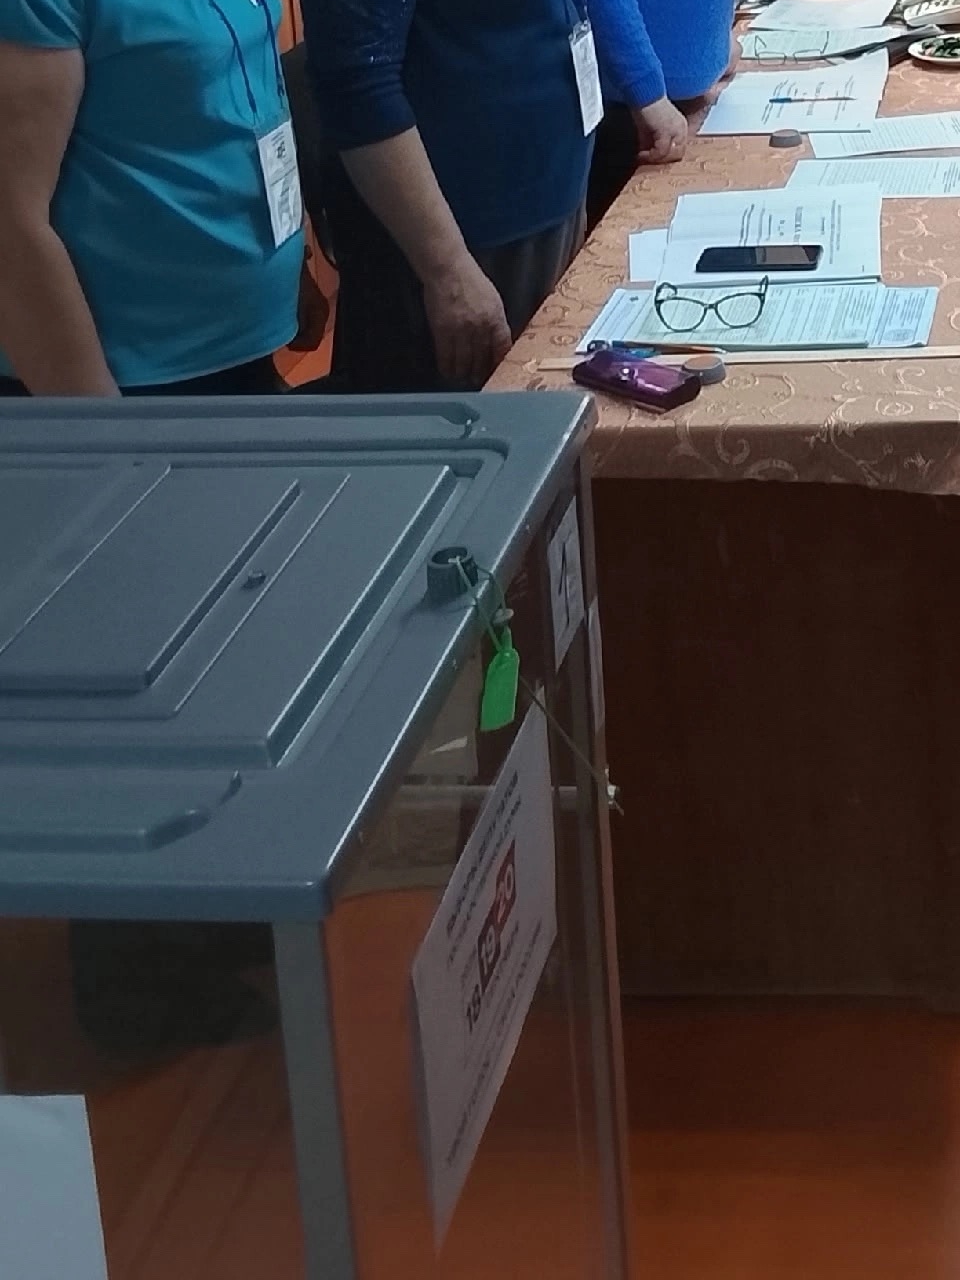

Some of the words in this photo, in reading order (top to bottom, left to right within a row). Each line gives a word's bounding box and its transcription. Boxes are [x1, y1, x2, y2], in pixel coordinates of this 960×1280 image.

[467, 983, 482, 1033] 18
[480, 924, 496, 972] 19
[497, 862, 514, 920] 20
